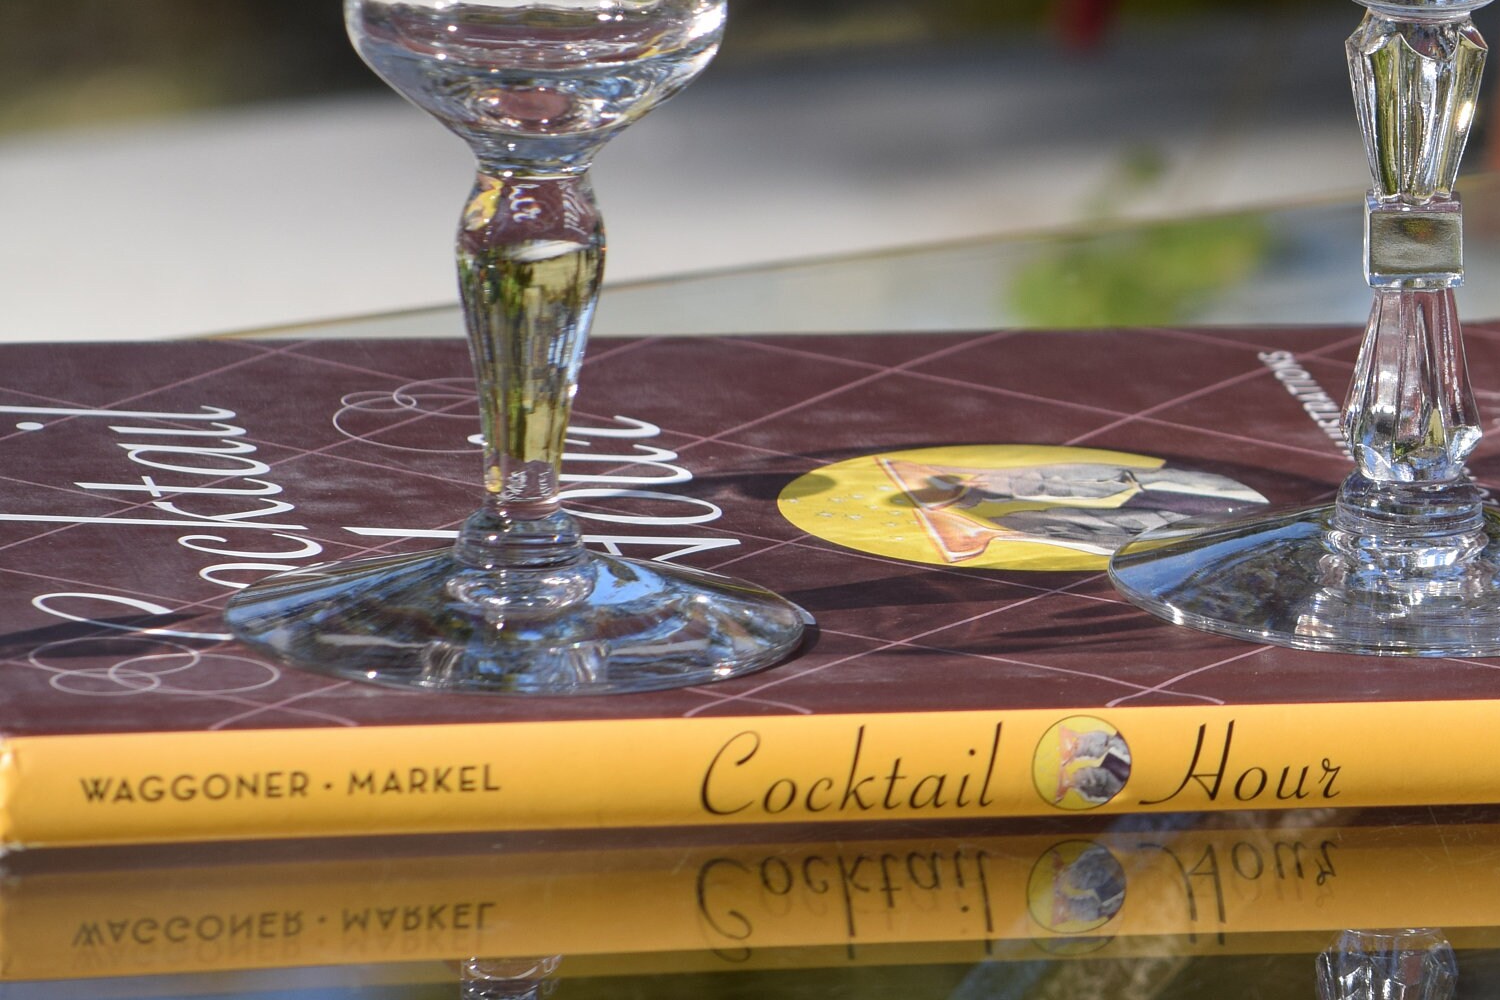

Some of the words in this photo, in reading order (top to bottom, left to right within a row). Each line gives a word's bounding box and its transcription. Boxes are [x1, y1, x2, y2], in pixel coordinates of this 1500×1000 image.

[80, 771, 310, 803] WAGGONER
[348, 763, 501, 796] MARKEL
[701, 721, 1003, 816] Cocktail
[1138, 719, 1341, 805] Hour
